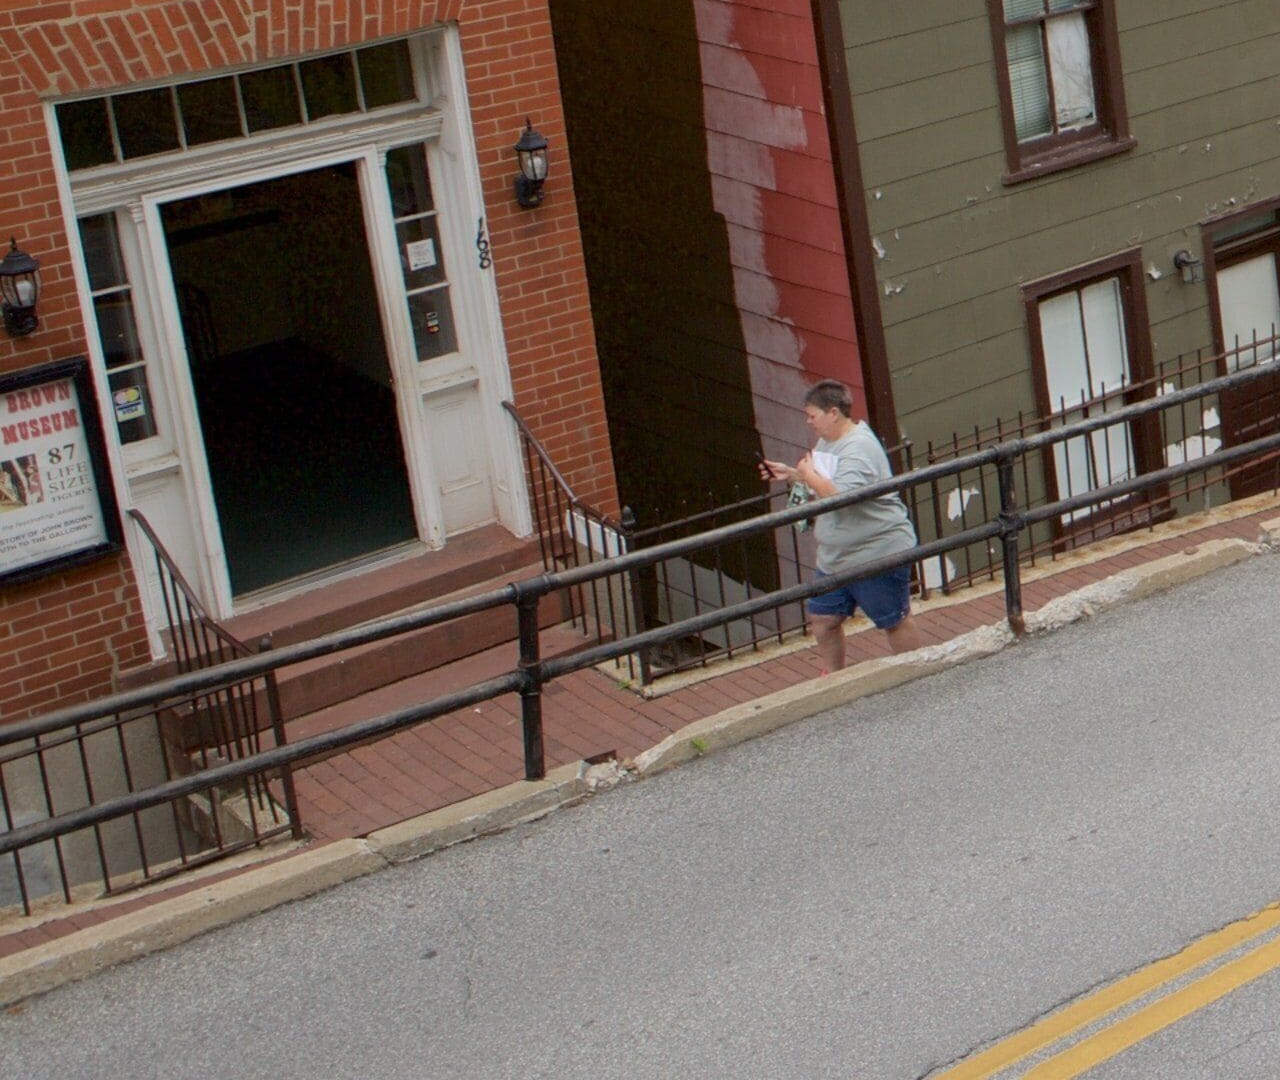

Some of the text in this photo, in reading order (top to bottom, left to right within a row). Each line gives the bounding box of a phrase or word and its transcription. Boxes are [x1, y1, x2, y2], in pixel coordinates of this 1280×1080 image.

[476, 217, 492, 269] 168
[6, 380, 71, 413] BROWN
[1, 408, 79, 445] MUSEUM
[48, 443, 75, 465] 87
[46, 461, 87, 482] LIFE
[49, 474, 90, 493] SIZE
[51, 487, 93, 502] FIGURES
[0, 514, 94, 546] STORY OF JOHN BROWN
[32, 535, 47, 544] THE
